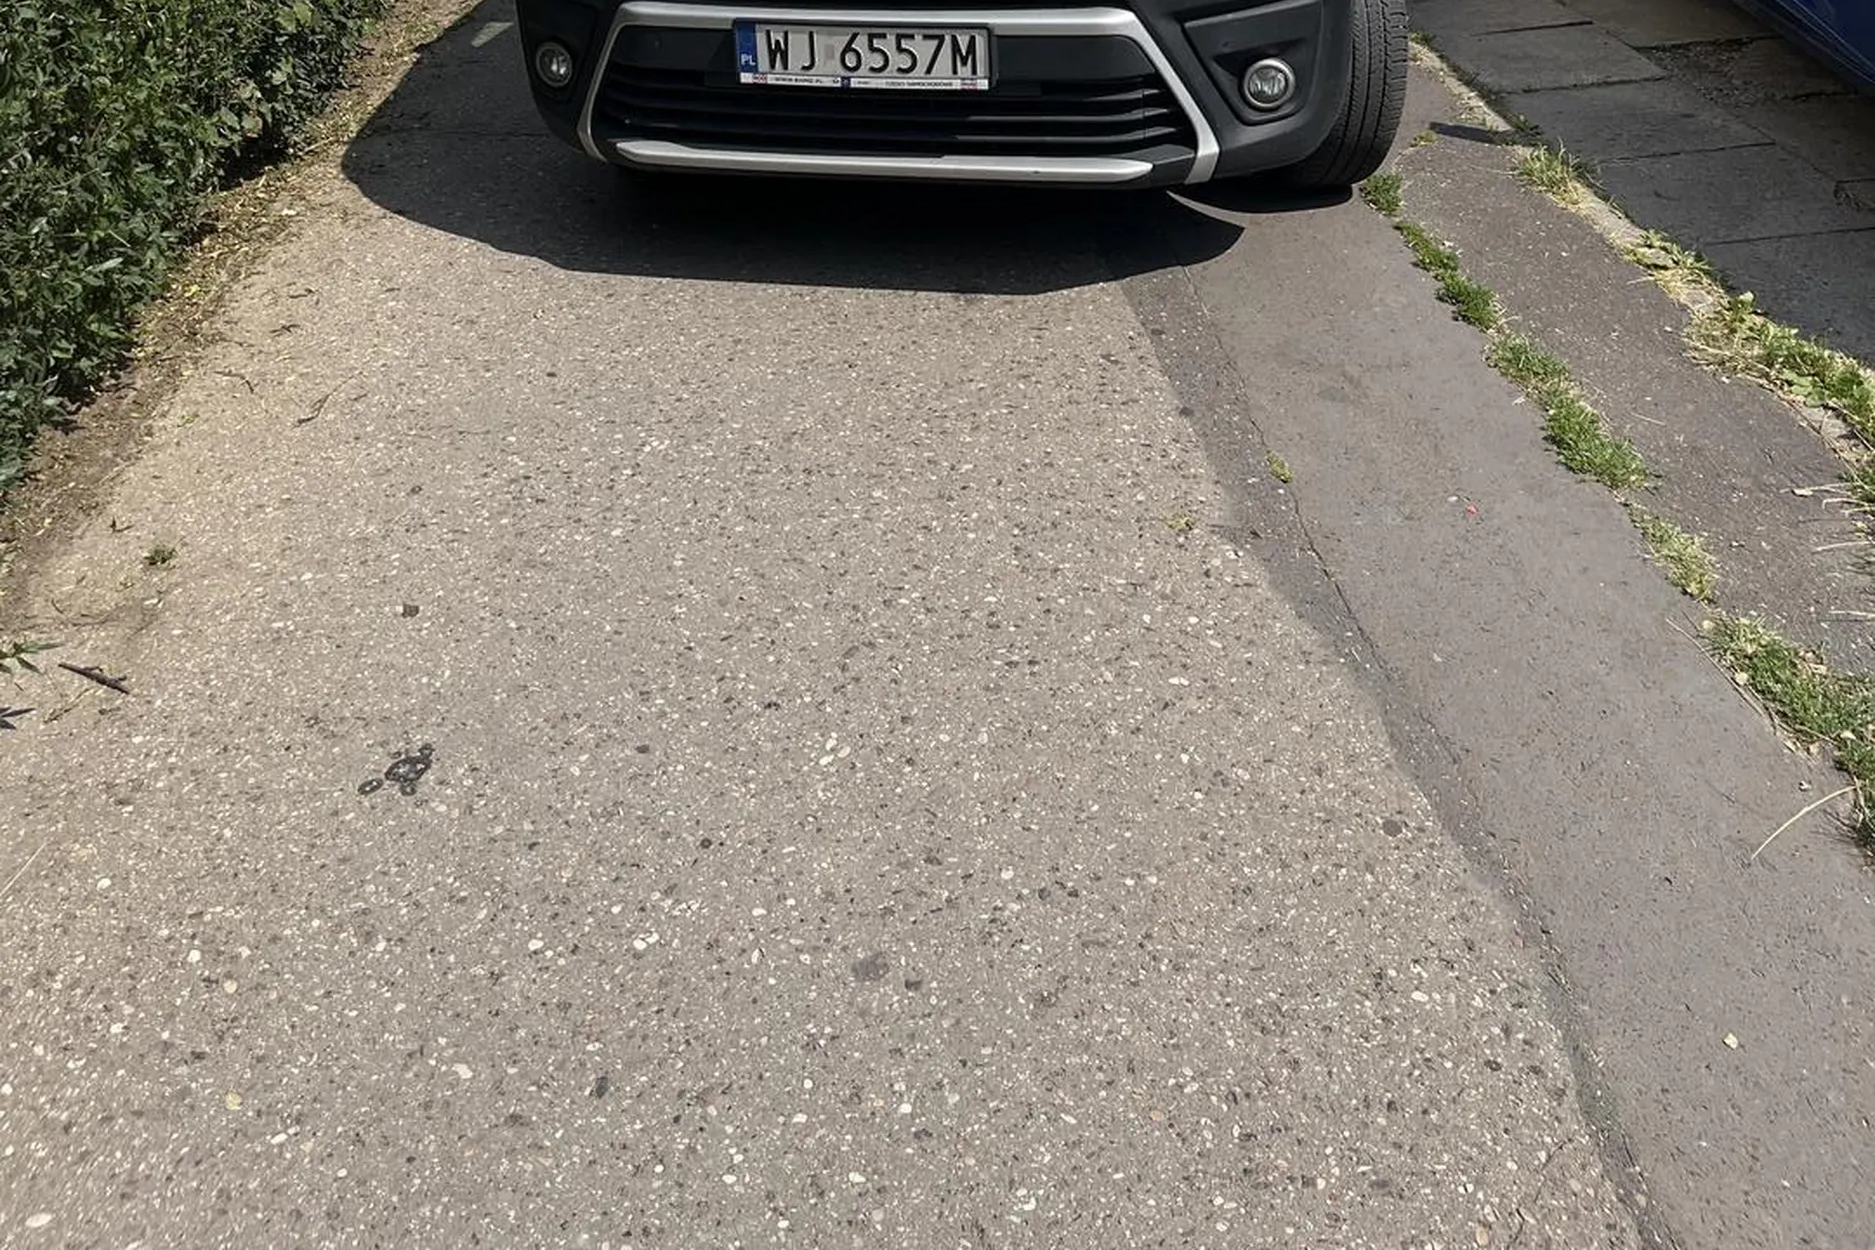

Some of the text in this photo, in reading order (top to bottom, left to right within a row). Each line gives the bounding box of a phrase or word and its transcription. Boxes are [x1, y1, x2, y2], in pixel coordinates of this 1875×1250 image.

[741, 55, 756, 67] PL
[766, 29, 978, 75] WJ 6557M
